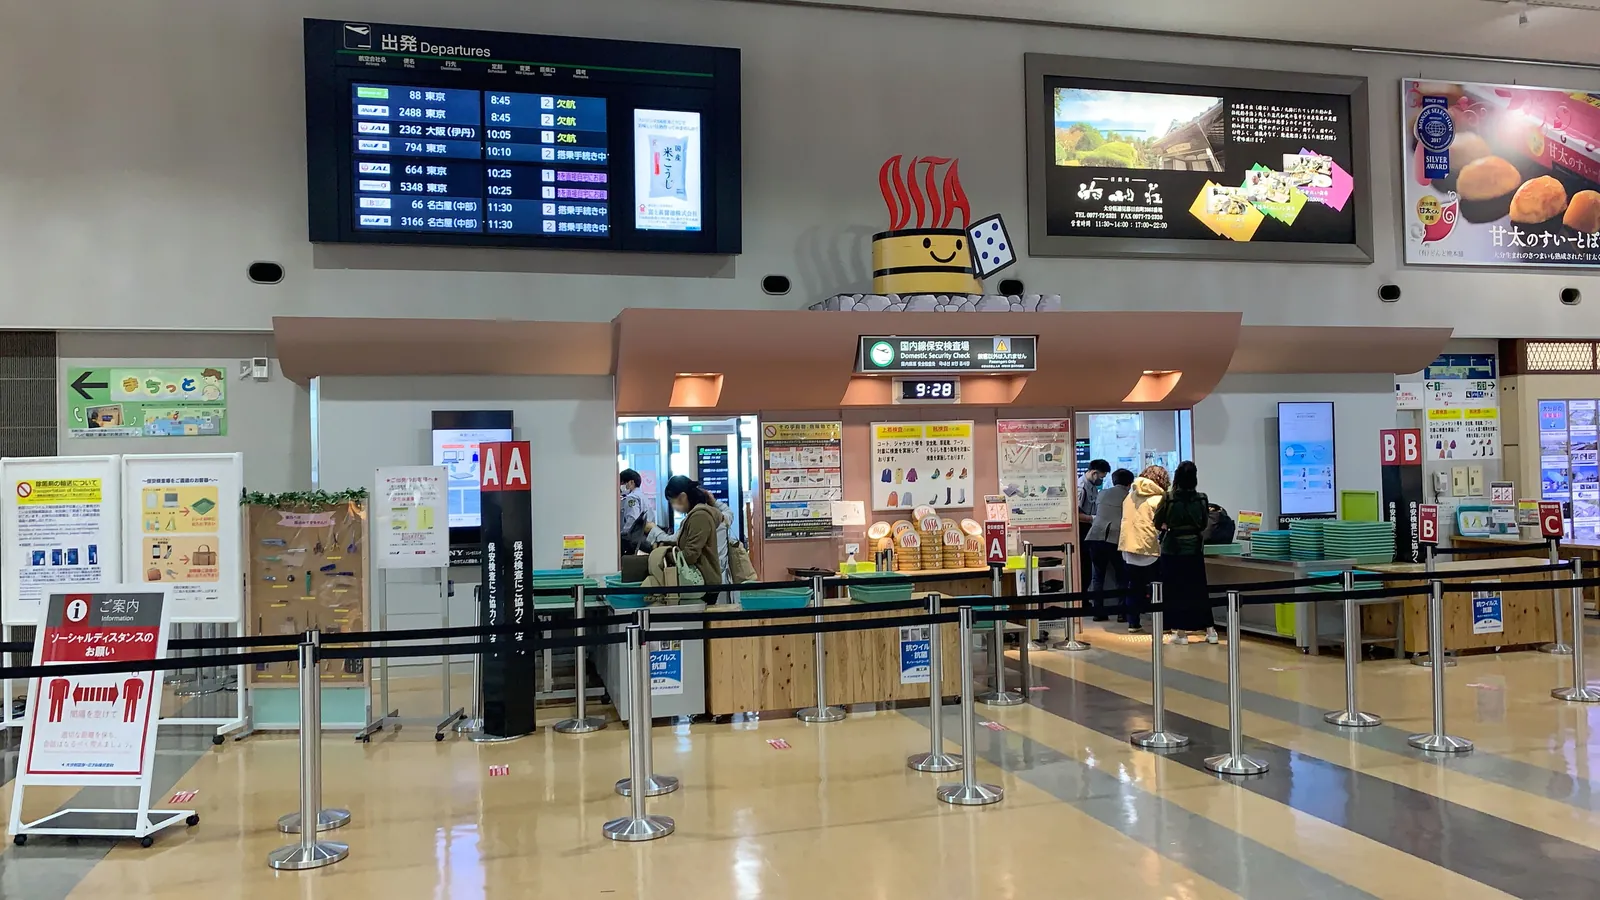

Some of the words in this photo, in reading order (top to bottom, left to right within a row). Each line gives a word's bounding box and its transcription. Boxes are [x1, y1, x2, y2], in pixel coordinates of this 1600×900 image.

[382, 34, 418, 52] 出発
[420, 42, 491, 57] Departures
[410, 91, 421, 100] 88
[425, 91, 446, 101] 東京
[491, 96, 510, 105] 8:45
[557, 99, 576, 109] 欠航
[399, 108, 421, 117] 2488
[425, 109, 446, 119] 東京
[491, 113, 510, 122] 8:45
[557, 116, 576, 126] 欠航
[1419, 110, 1430, 129] MONDE
[1431, 108, 1453, 131] SELECTION
[400, 125, 422, 135] 2362
[487, 130, 511, 139] 10:05
[557, 134, 576, 143] 欠航
[405, 143, 422, 152] 794
[426, 144, 446, 153] 東京
[487, 147, 511, 156] 10:10
[557, 150, 606, 161] 搭乗手続き中
[675, 145, 681, 161] 国産
[405, 165, 422, 174] 664
[426, 166, 447, 176] 東京
[487, 169, 512, 178] 10:25
[664, 147, 673, 190] 米こうじ
[400, 182, 423, 192] 5348
[427, 184, 447, 193] 東京
[488, 186, 512, 195] 10:25
[412, 200, 423, 209] 66
[427, 201, 477, 211] 名古屋(中部)
[488, 203, 512, 212] 11:30
[558, 206, 607, 216] 搭乗手続き中
[401, 217, 423, 226] 3166
[428, 218, 478, 228] 名古屋(中部)
[488, 220, 513, 229] 11:30
[558, 222, 608, 232] 搭乗手続き中
[1489, 226, 1600, 248] 甘太のすいーとぽ
[900, 341, 970, 351] 国内線保安検査場
[916, 383, 952, 396] 9:28
[1384, 434, 1395, 462] B
[1404, 433, 1417, 461] B
[483, 448, 499, 486] A
[506, 448, 527, 485] A
[1424, 520, 1434, 538] B
[1545, 516, 1559, 533] C
[989, 538, 1003, 558] A
[100, 598, 140, 613] ご案内
[51, 632, 154, 644] ソーシャルディスタンスの
[85, 646, 115, 657] お願い
[650, 654, 676, 662] ウイルス
[914, 651, 928, 659] 抗菌
[652, 662, 667, 670] 抗菌
